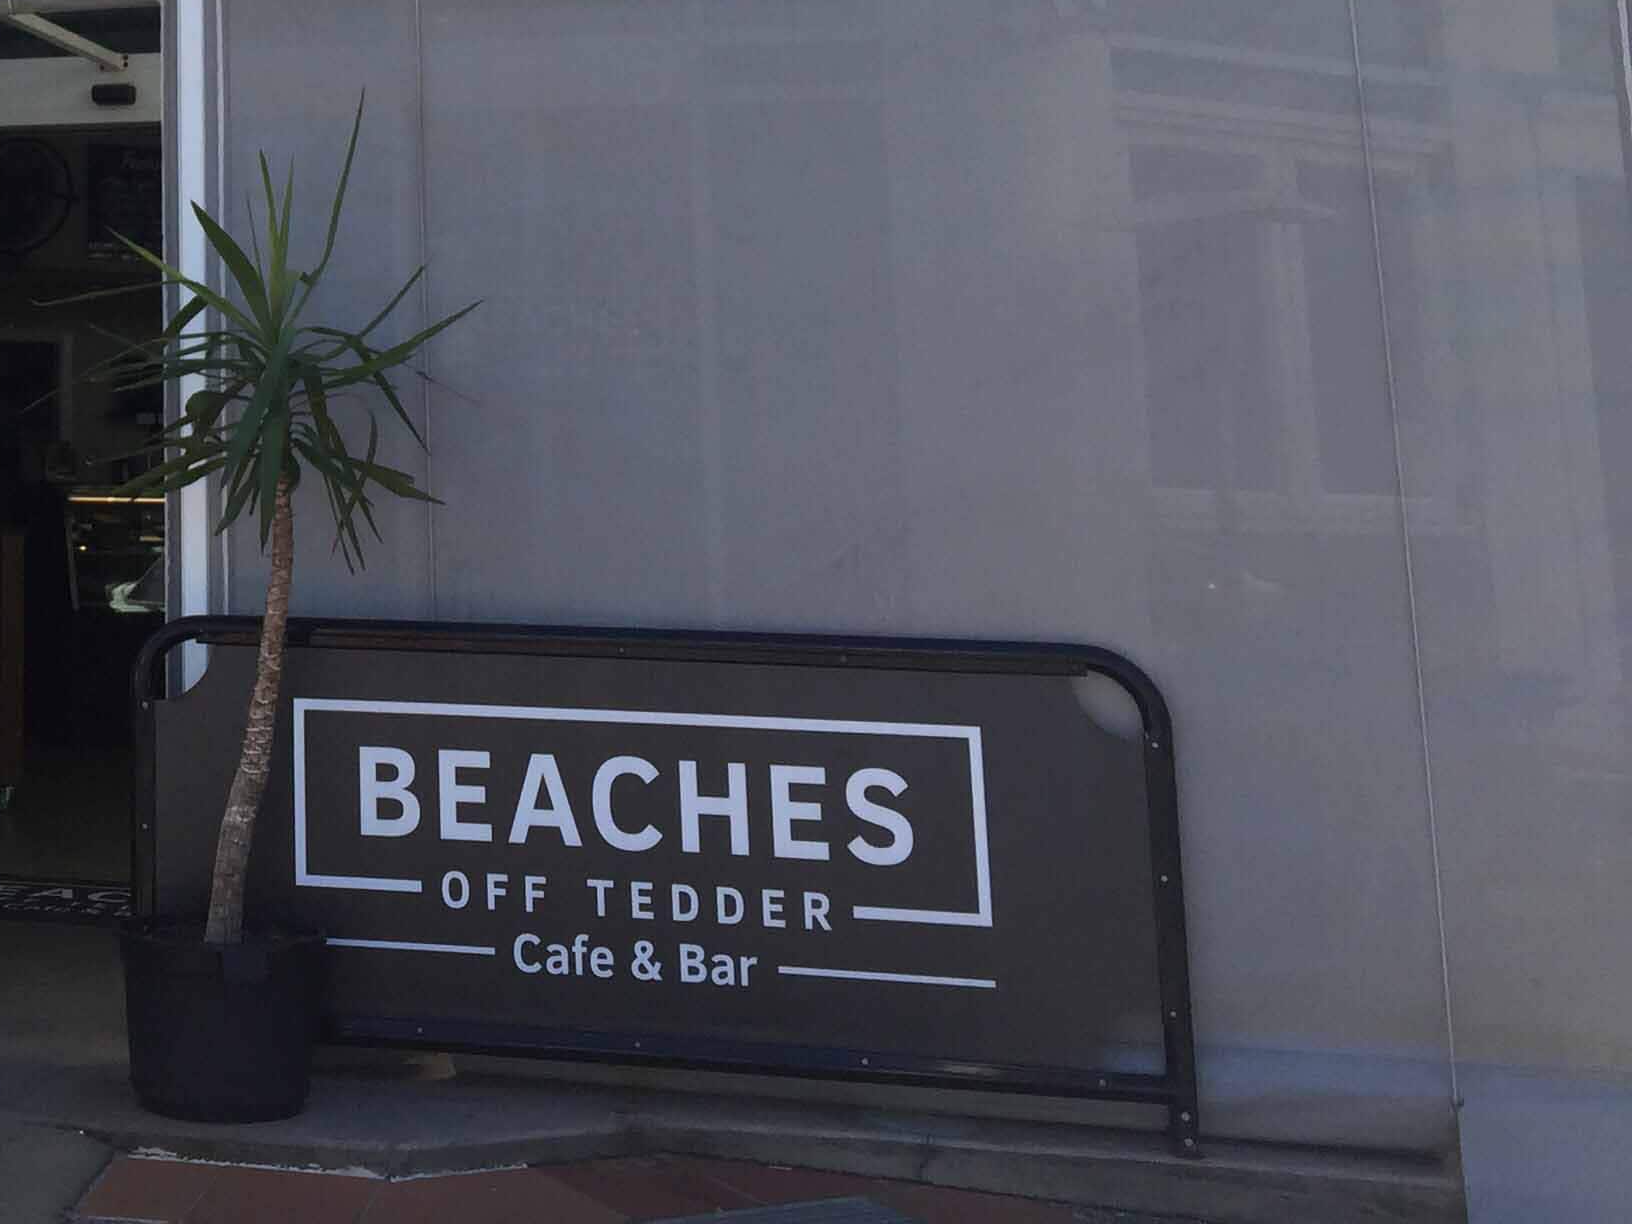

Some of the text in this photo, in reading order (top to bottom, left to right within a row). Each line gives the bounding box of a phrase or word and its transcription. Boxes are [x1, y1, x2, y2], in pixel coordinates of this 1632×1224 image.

[358, 746, 915, 866] BEACHES
[441, 870, 833, 932] OFF TEDDER
[513, 933, 759, 987] Cafe & Bar
